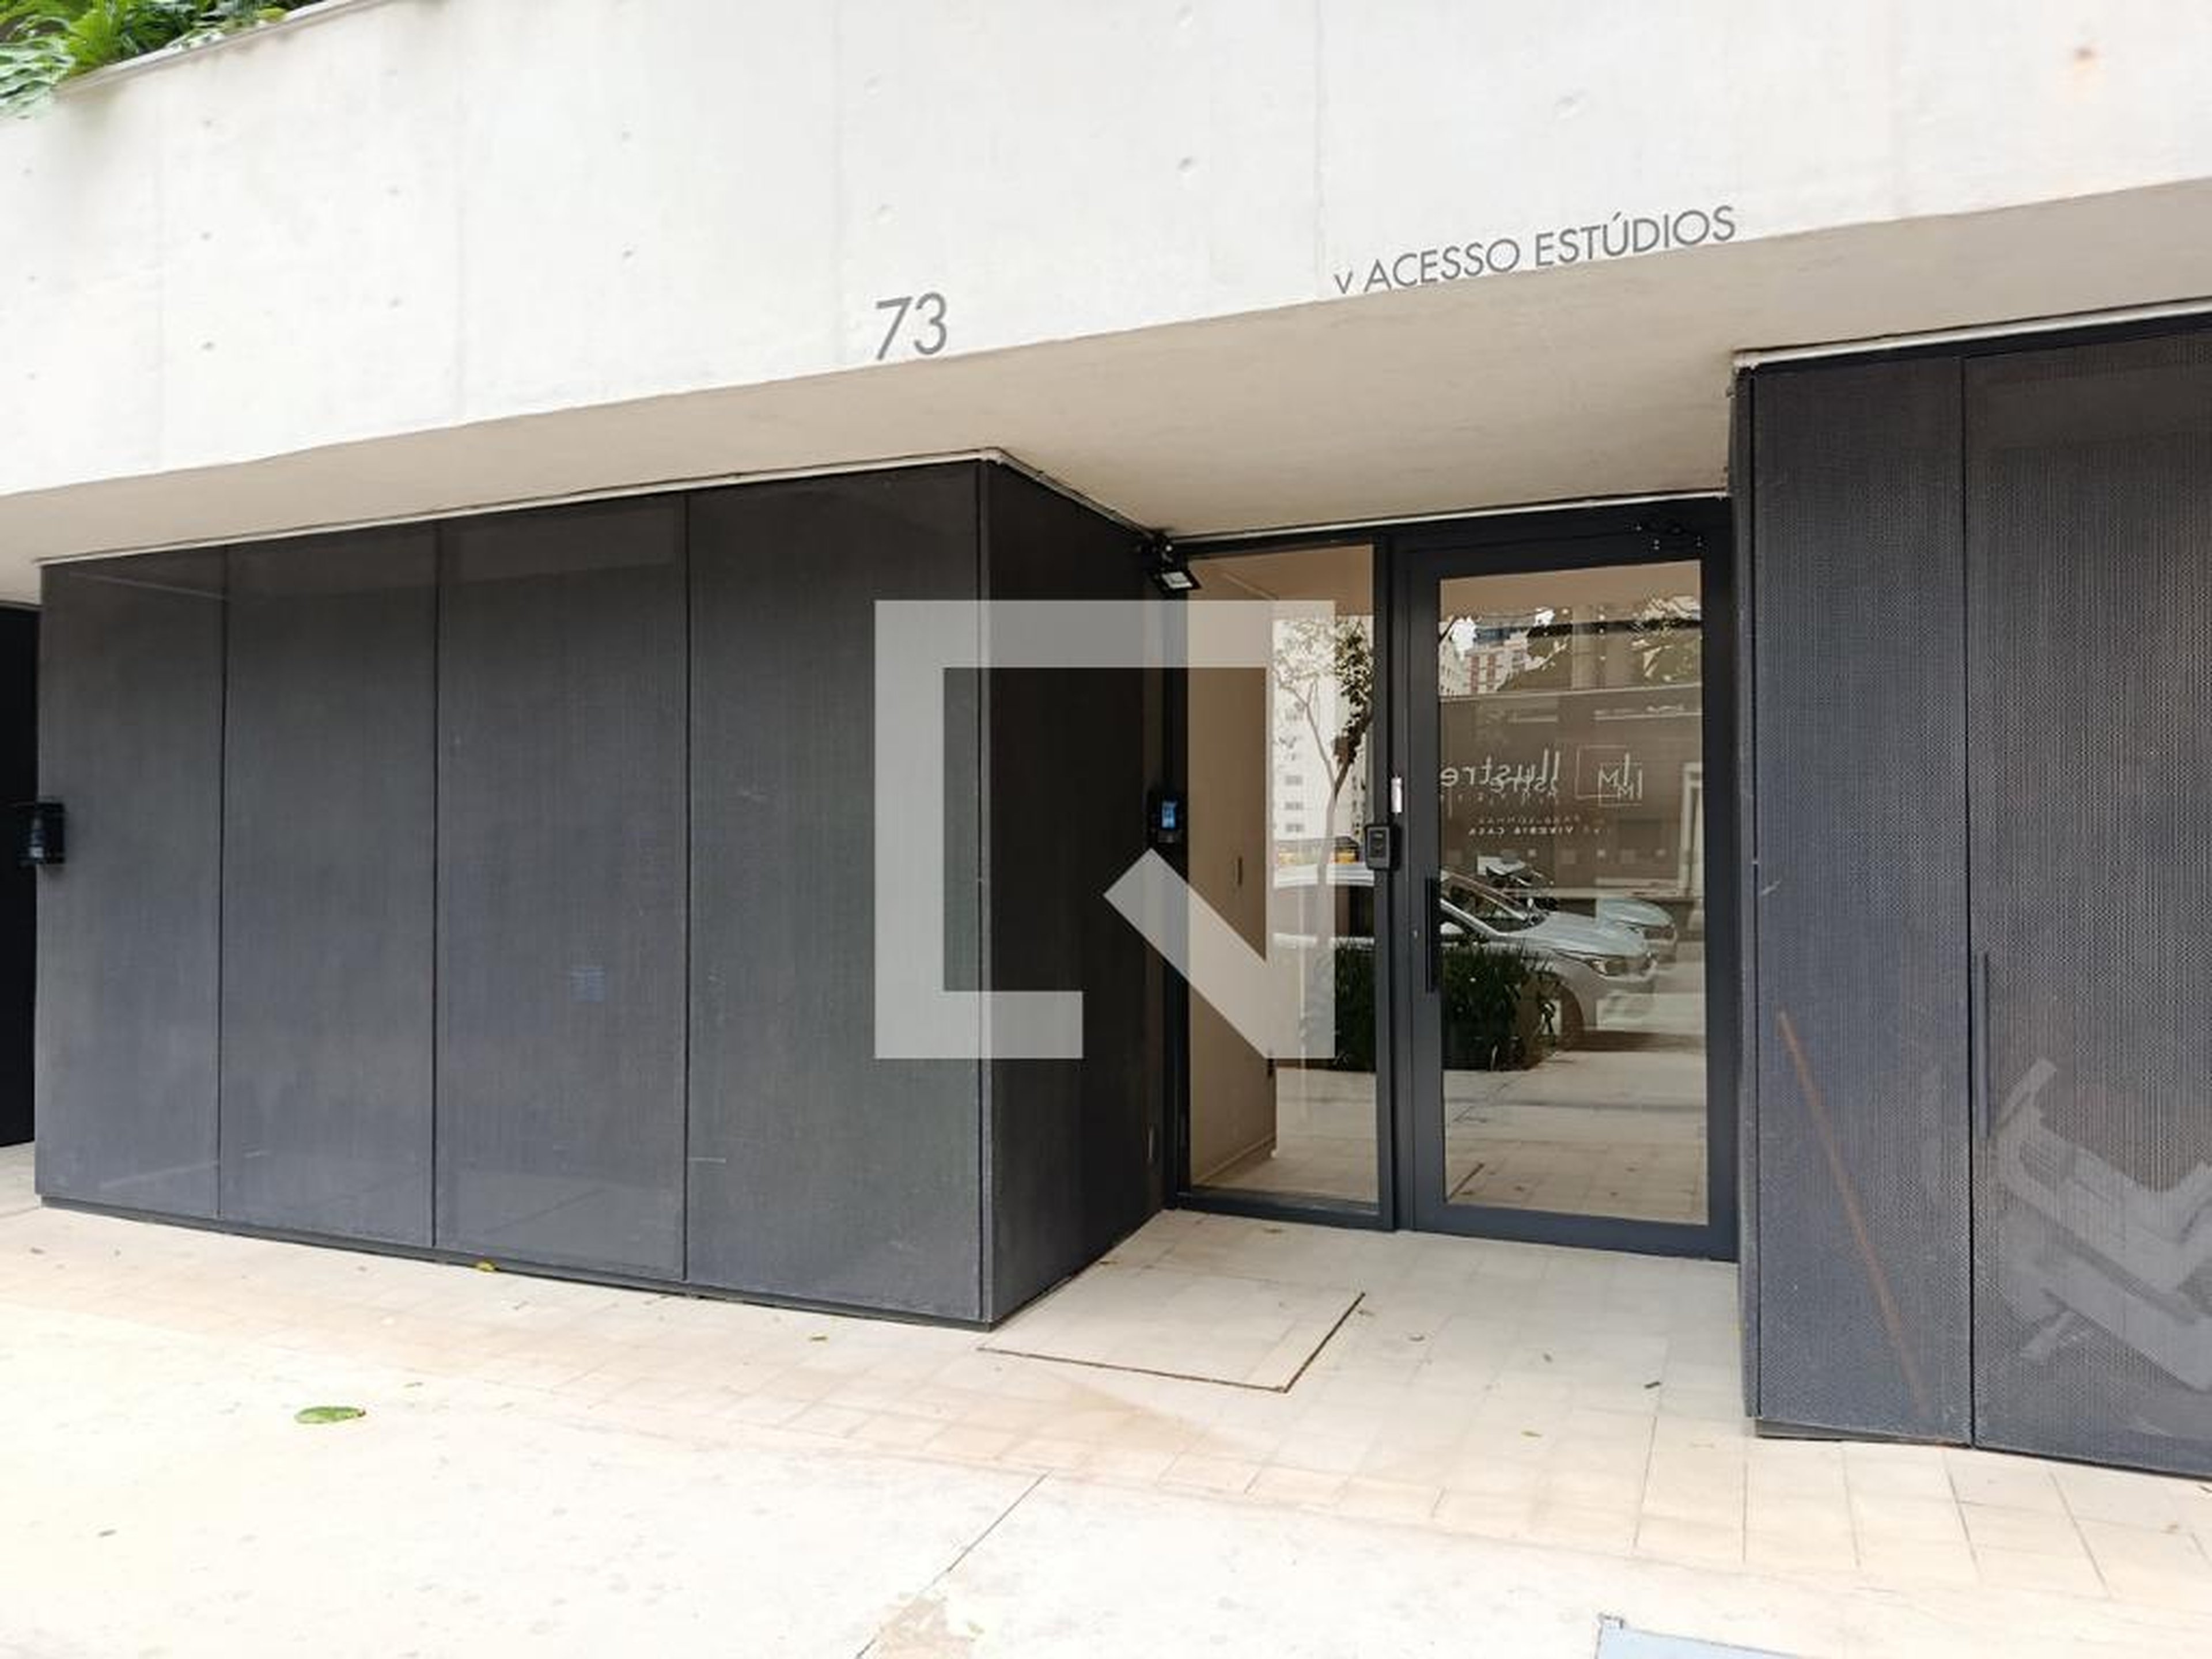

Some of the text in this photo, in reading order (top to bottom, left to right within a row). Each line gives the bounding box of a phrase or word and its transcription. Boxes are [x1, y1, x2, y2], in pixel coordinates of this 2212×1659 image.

[1363, 238, 1520, 293] ACESSO
[1536, 205, 1735, 268] ESTÚDIOS
[877, 293, 947, 361] 73
